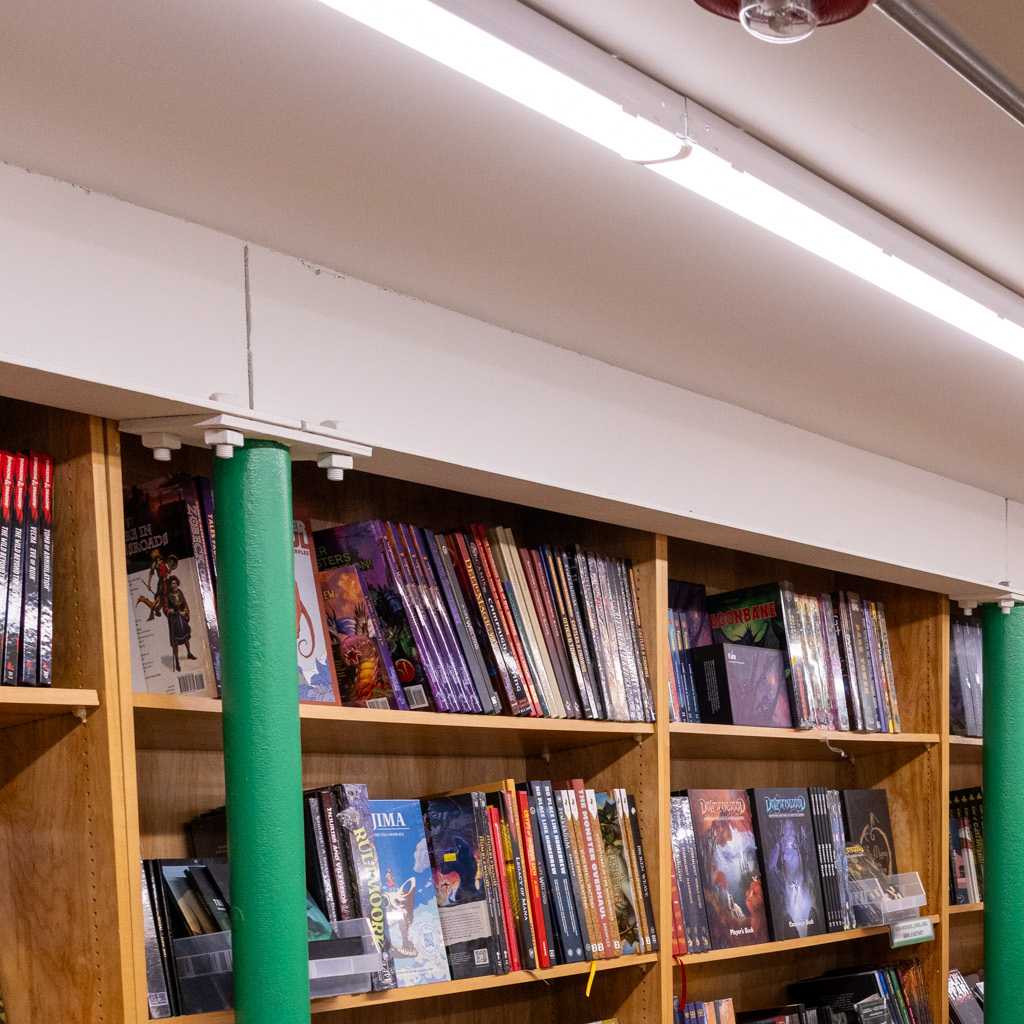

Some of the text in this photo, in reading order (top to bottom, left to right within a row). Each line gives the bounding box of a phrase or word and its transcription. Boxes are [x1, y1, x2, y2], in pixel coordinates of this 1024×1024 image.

[43, 529, 51, 543] TOMB
[42, 551, 51, 592] ANNIHILATION
[465, 558, 493, 633] DEEP MAGIC
[710, 602, 777, 629] AGONBANE
[371, 812, 406, 830] JIMA
[535, 785, 557, 875] NO PLACE LIKE HOMEBREW
[544, 785, 550, 797] NO
[547, 797, 555, 819] PLACE
[555, 835, 566, 875] HOMEBREW
[515, 856, 528, 920] LEGACY OF MANA
[577, 789, 611, 947] THE MONSTER OVERHAUL SKERPLES
